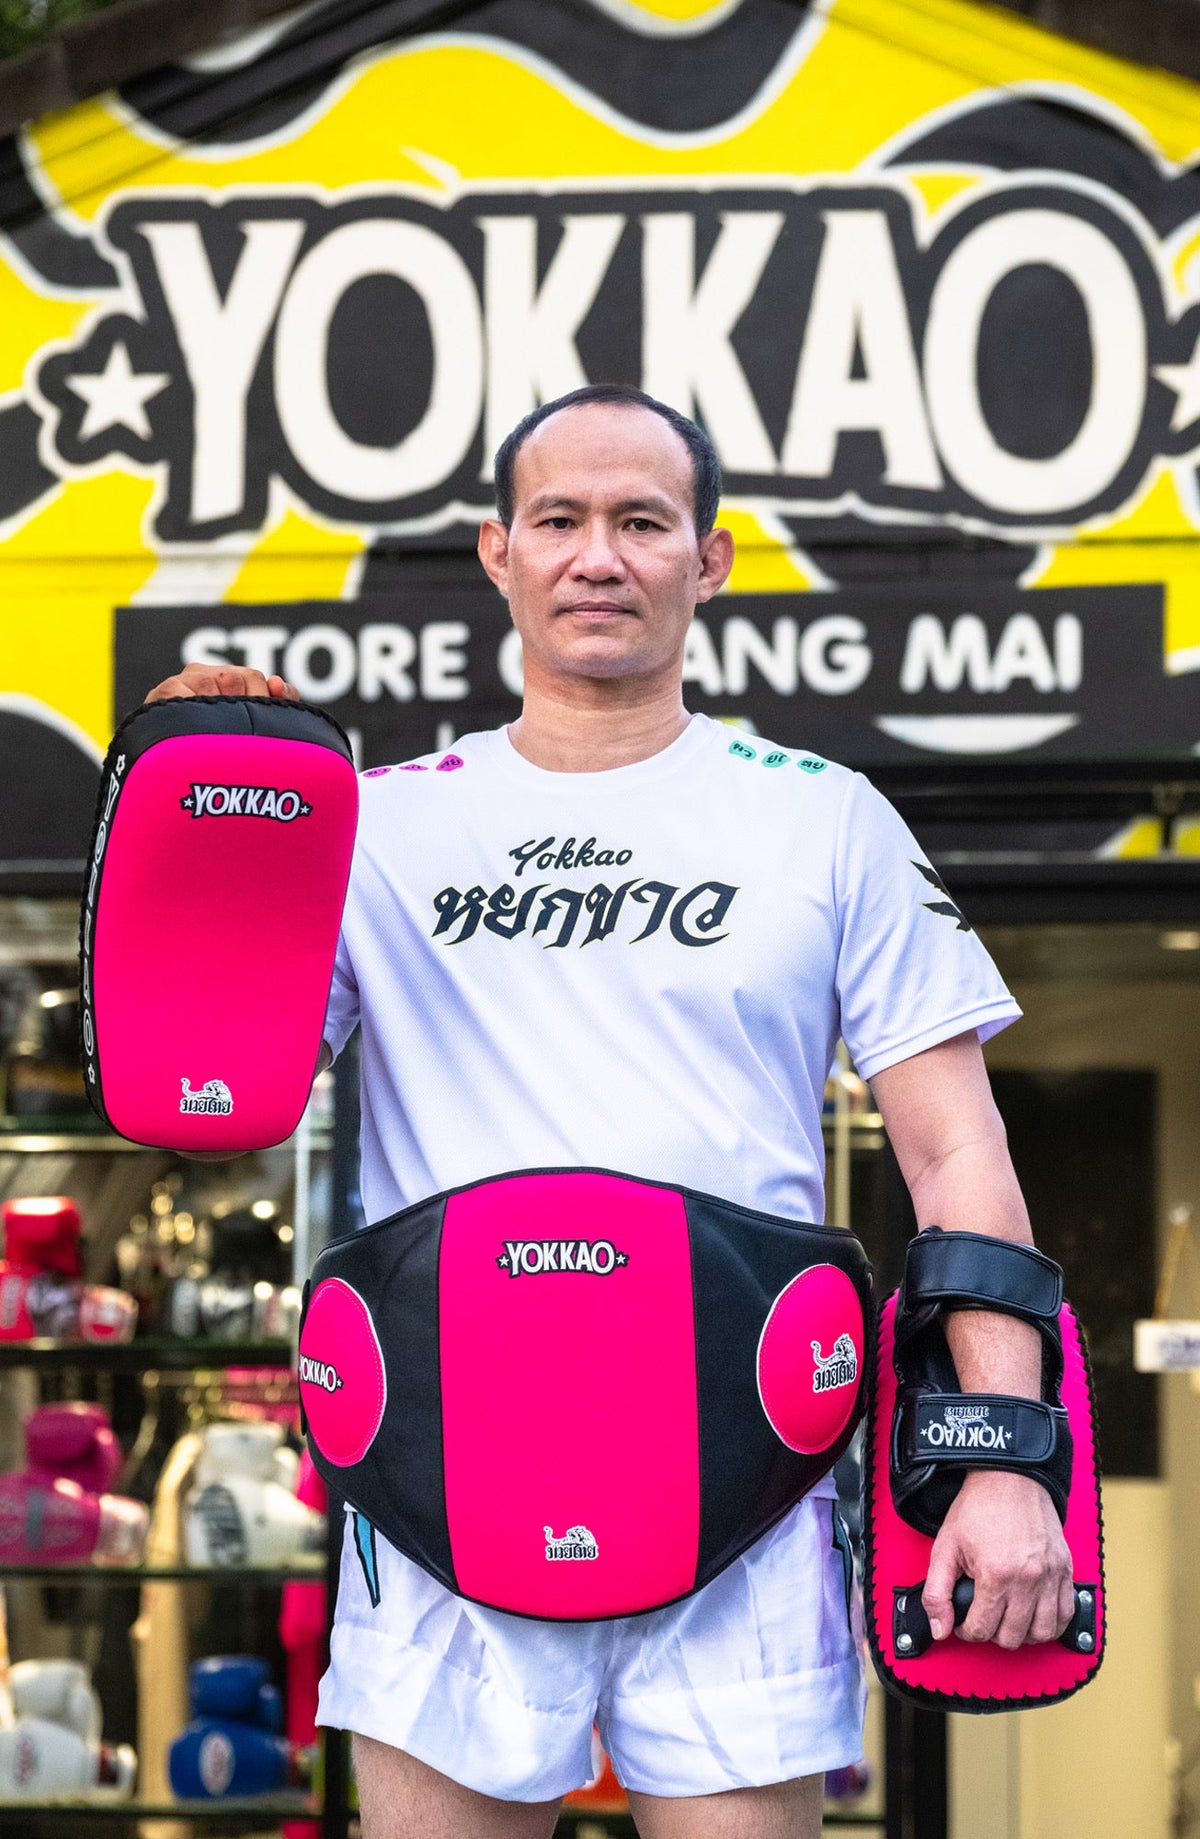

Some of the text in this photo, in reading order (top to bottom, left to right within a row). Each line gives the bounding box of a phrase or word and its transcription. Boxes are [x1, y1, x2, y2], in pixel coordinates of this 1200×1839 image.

[135, 207, 1148, 524] YOKKAO
[900, 612, 1083, 694] MAI
[192, 784, 300, 821] YOKKAO
[508, 836, 633, 877] Yokkao
[506, 1240, 616, 1276] YOKKAO
[927, 1422, 1007, 1449] YOKKAO
